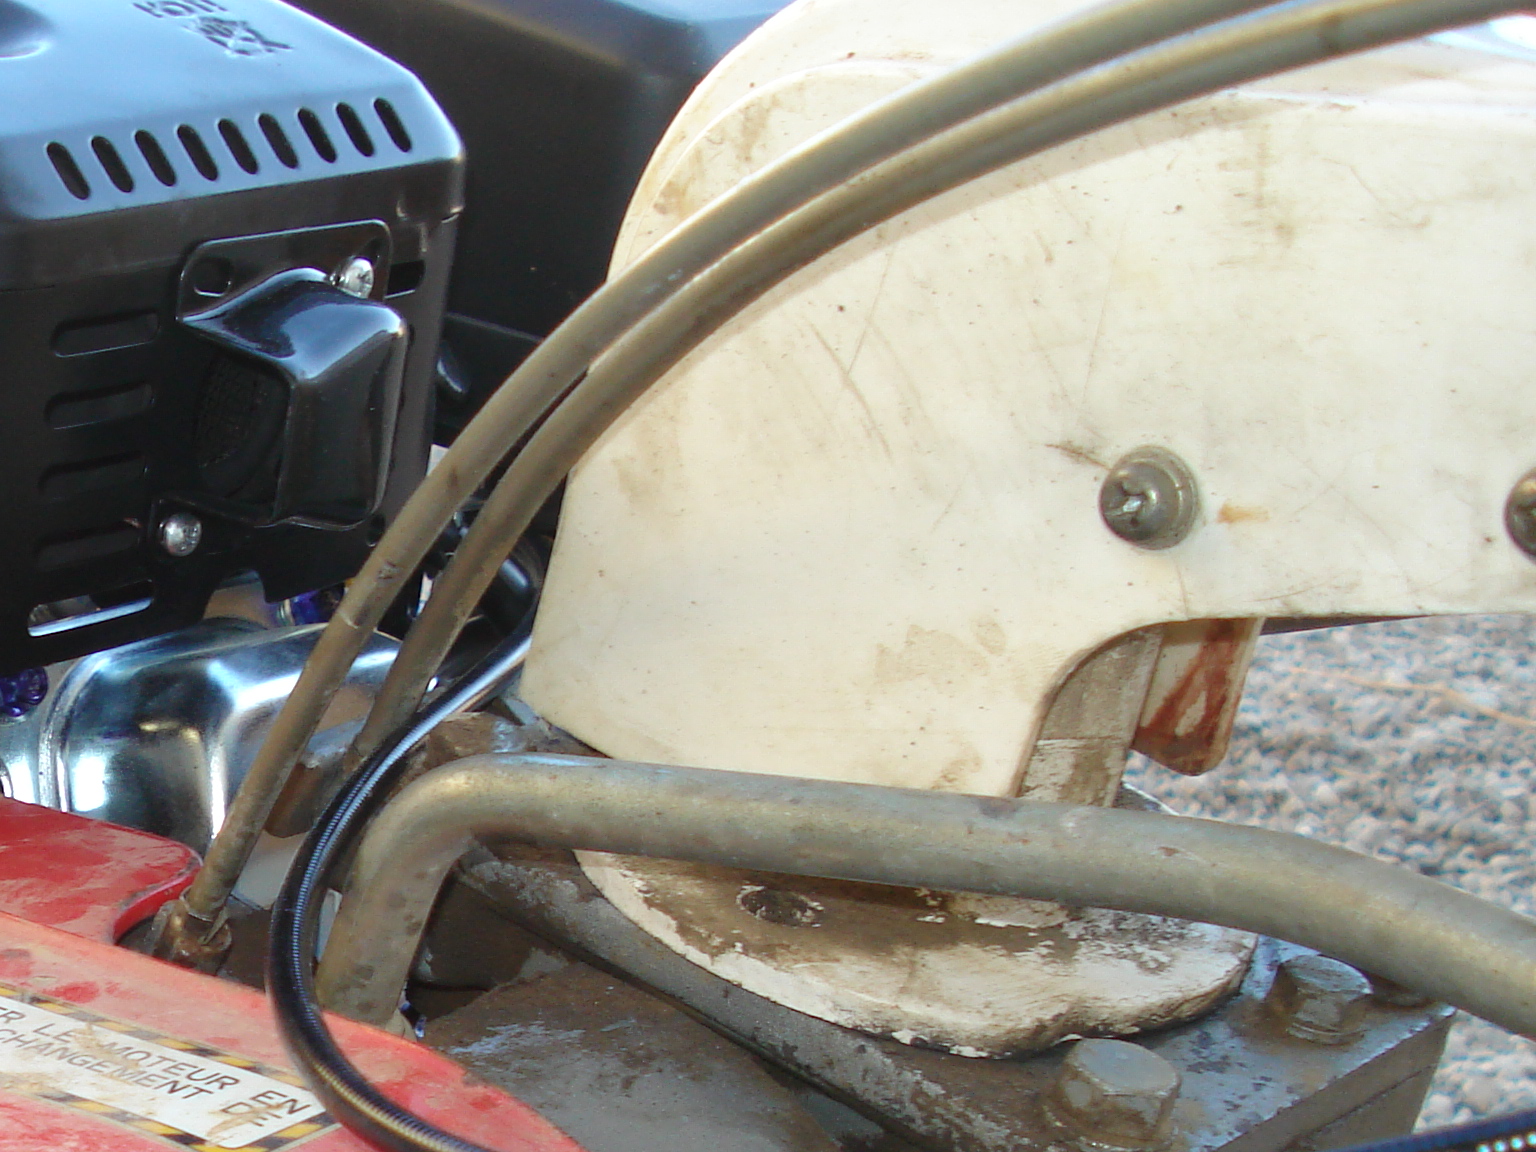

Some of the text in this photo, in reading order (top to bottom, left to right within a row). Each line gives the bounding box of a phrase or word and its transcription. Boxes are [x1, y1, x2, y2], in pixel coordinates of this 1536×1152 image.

[32, 1022, 75, 1044] LE
[100, 1042, 240, 1090] MOTEUR
[250, 1090, 312, 1115] EN
